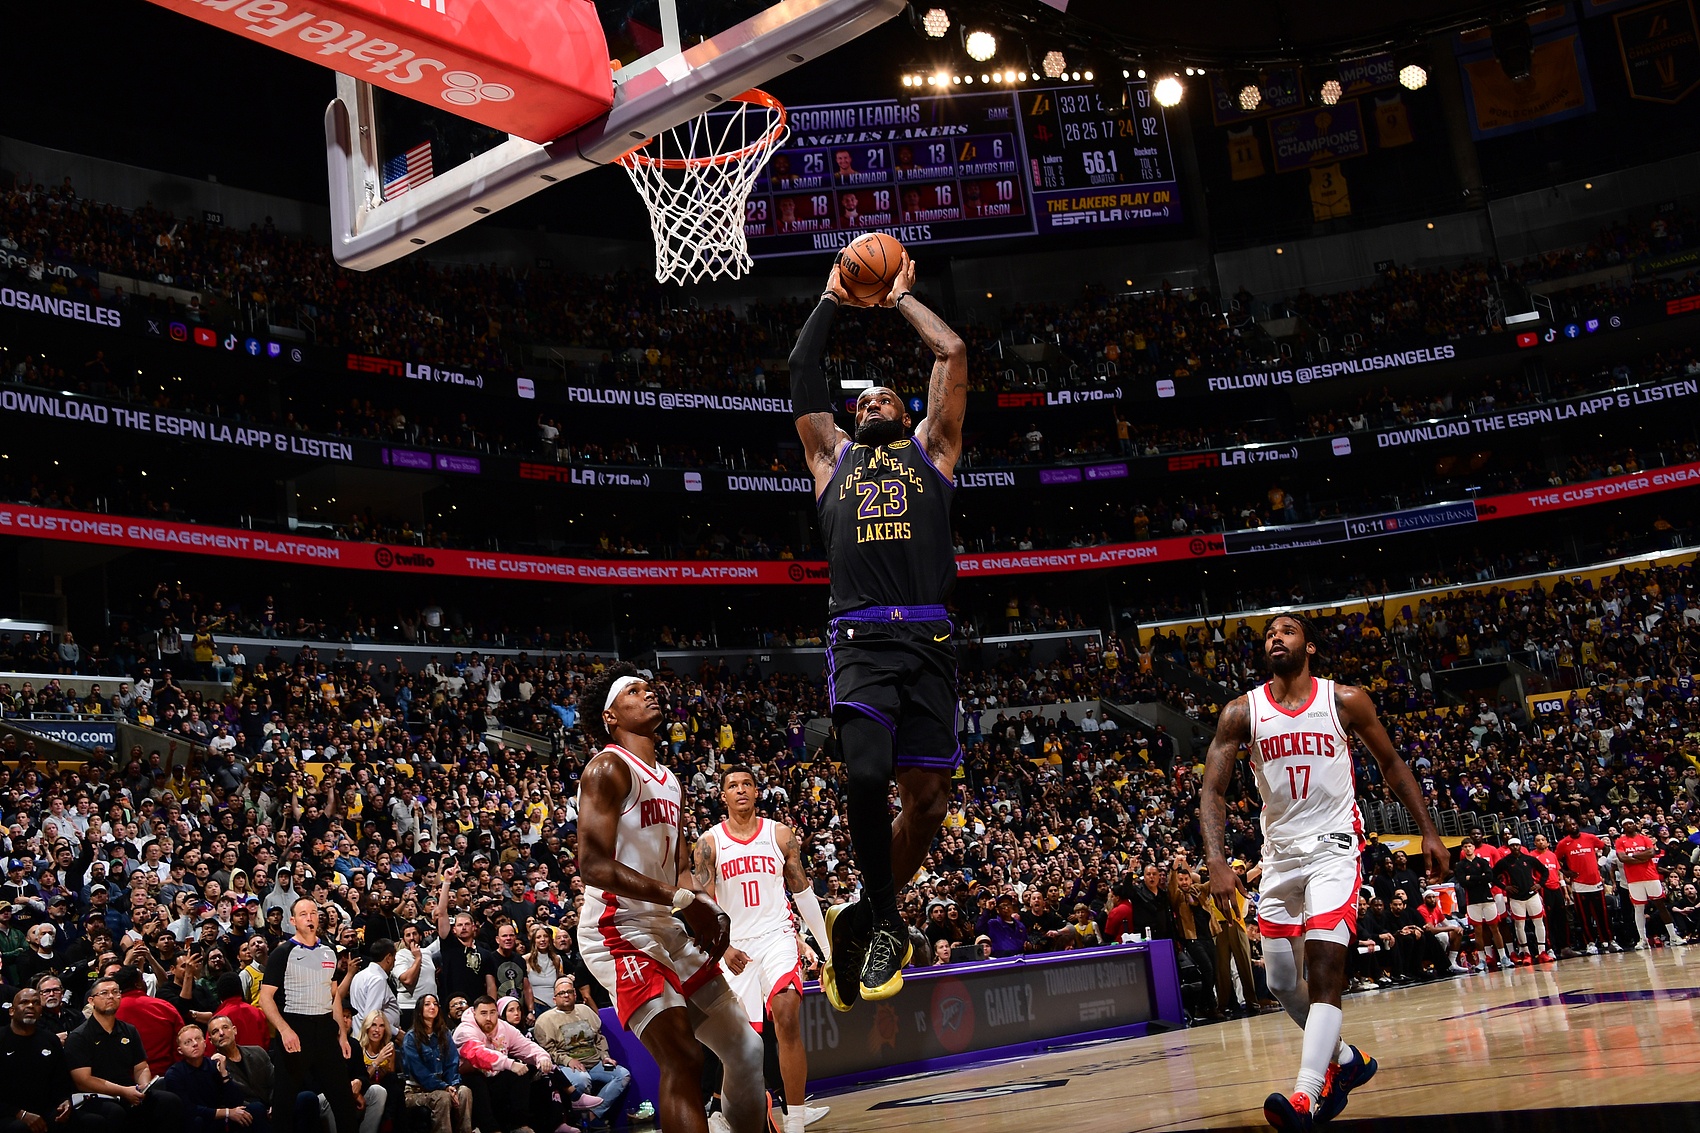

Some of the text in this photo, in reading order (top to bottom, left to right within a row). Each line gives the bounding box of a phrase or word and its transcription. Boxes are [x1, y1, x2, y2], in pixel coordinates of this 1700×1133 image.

[1629, 33, 1694, 60] CHAMPIONS
[1060, 90, 1150, 114] 33 21 97
[1489, 106, 1519, 119] WORLD
[1521, 88, 1570, 117] CHAMPIONS
[791, 103, 920, 132] SCORING LEADERS
[988, 108, 1009, 119] GAME
[1386, 114, 1396, 129] 9
[888, 124, 969, 140] LAKERS
[1065, 117, 1158, 141] 26 25 17 24 92
[929, 144, 945, 164] 13
[992, 139, 1003, 159] 6
[1236, 146, 1254, 163] 11
[1279, 130, 1359, 158] CHAMPIONS
[1337, 142, 1360, 155] 2016
[804, 153, 824, 174] 25
[867, 148, 884, 169] 21
[965, 162, 998, 175] PLAYERS
[999, 160, 1015, 172] TIED
[1082, 150, 1118, 175] 56.1
[907, 165, 954, 179] HACHIMURA
[1321, 172, 1332, 188] 3
[781, 176, 823, 190] M. SMART
[996, 180, 1013, 201] 10
[811, 195, 828, 216] 18
[873, 190, 890, 211] 18
[935, 185, 952, 206] 16
[1047, 191, 1171, 212] THE LAKERS PLAY ON
[206, 212, 221, 223] 303
[747, 200, 767, 222] 23
[914, 208, 960, 222] THOMPSON
[984, 203, 1011, 215] EASON
[1051, 209, 1123, 226] ESPN LA
[790, 219, 818, 232] SMITH
[0, 287, 121, 328] OSANGELES
[347, 354, 431, 381] ESPN LA
[1208, 345, 1456, 391] FOLLOW US @ESPNLOSANGELES
[568, 387, 656, 406] FOLLOW US
[997, 390, 1072, 407] ESPN LA
[1377, 379, 1698, 448] DOWNLOAD THE ESPN LA APP & LISTEN
[0, 391, 354, 460] OWNLOAD THE ESPN LA APP & LISTEN
[1168, 451, 1246, 473] ESPN LA
[519, 463, 596, 486] ESPN LA
[839, 445, 924, 501] LOS ANGELES
[962, 471, 1016, 488] LISTEN
[727, 476, 813, 493] DOWNLOAD
[1528, 475, 1650, 507] THE CUSTOMER
[855, 478, 908, 520] 23
[17, 513, 123, 538] CUSTOMER
[128, 526, 250, 551] ENGAGEMENT
[253, 538, 340, 560] PLATFORM
[856, 522, 912, 544] LAKERS
[1350, 520, 1383, 535] 10:11
[394, 552, 434, 568] twilio
[466, 557, 757, 578] THE CUSTOMER ENGAGEMENT PLATFORM
[982, 551, 1076, 570] ENGAGEMENT
[1080, 546, 1158, 564] PLATFORM
[1536, 700, 1562, 713] 106
[1259, 732, 1335, 763] ROCKETS
[1285, 765, 1311, 800] 17
[640, 798, 681, 829] ROCKET
[720, 856, 776, 881] ROCKETS
[740, 880, 760, 908] 10
[1043, 965, 1097, 997] TOMORROW
[1127, 962, 1138, 985] ET
[984, 983, 1036, 1028] GAME 2
[1079, 998, 1116, 1022] ESPN
[915, 1010, 927, 1033] VS
